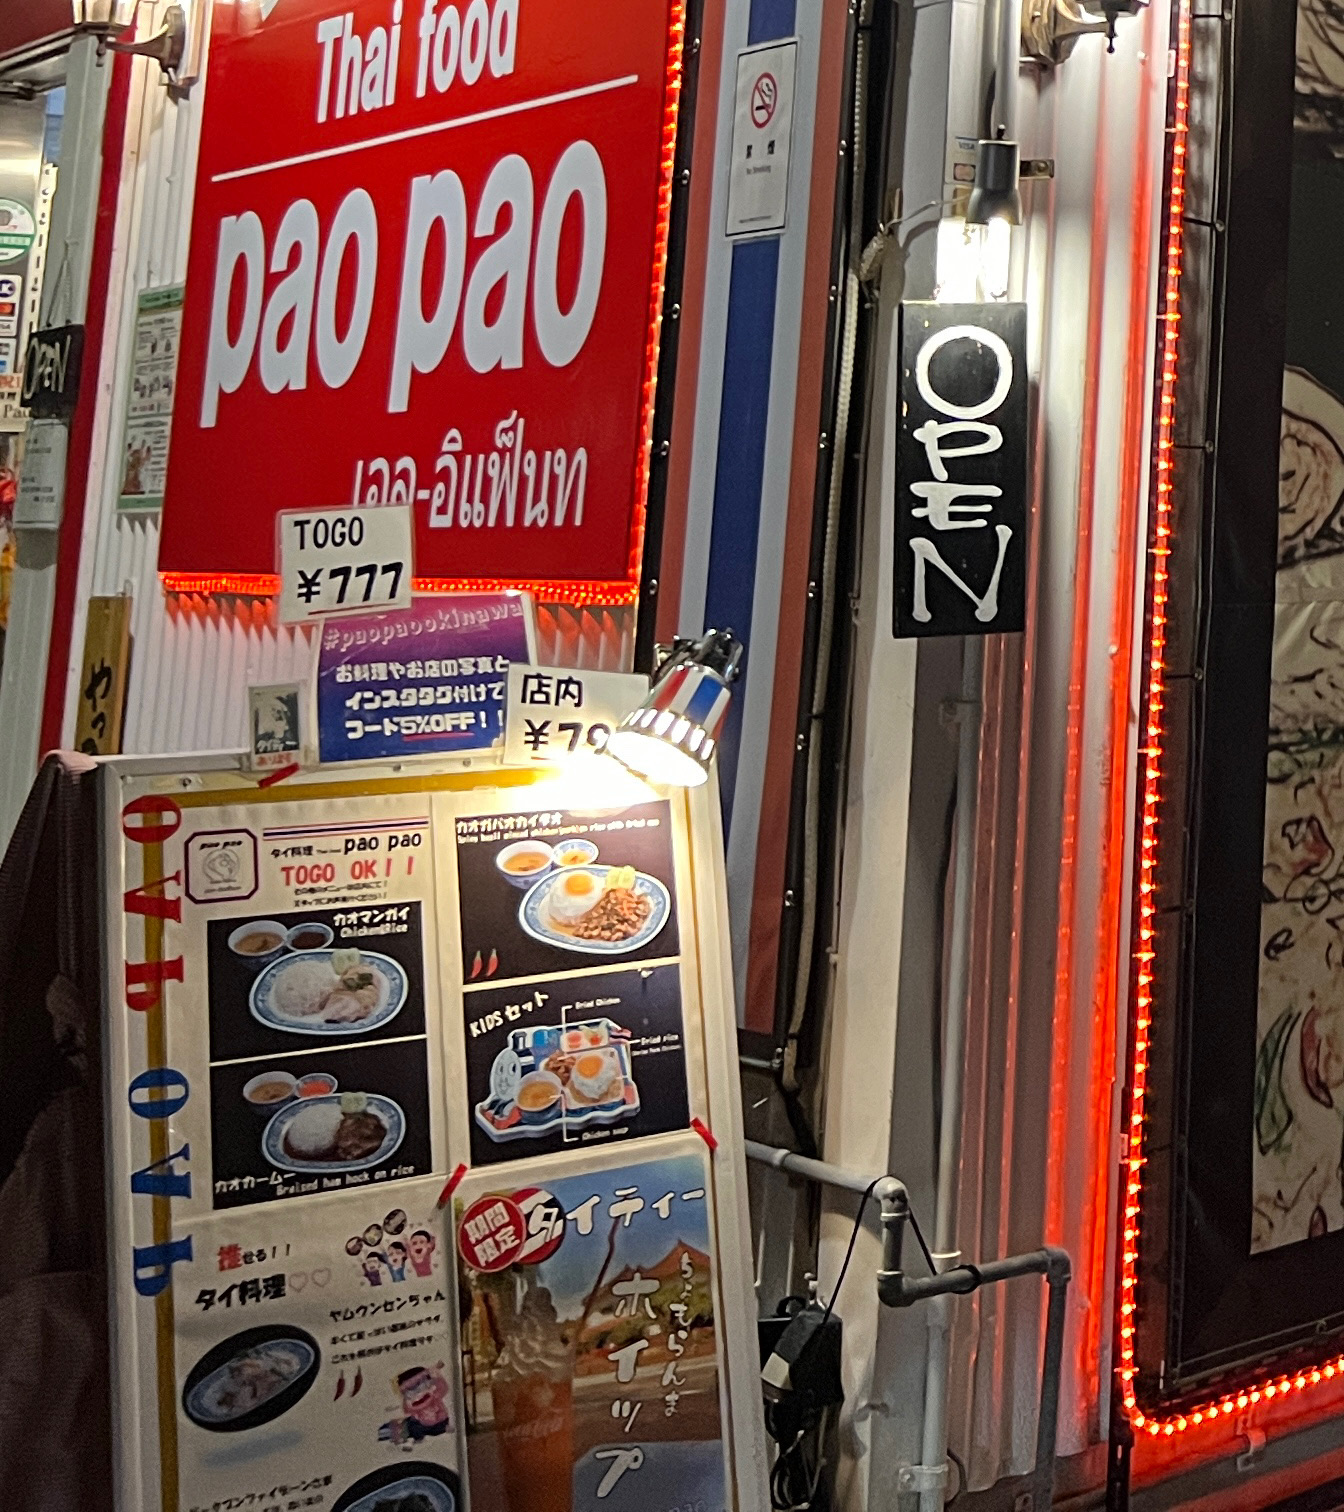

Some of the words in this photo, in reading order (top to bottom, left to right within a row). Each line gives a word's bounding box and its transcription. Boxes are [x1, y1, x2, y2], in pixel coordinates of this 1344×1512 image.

[200, 187, 379, 428] pao
[387, 139, 608, 413] pao
[909, 325, 1014, 623] OPEN
[294, 516, 365, 550] TOGO
[297, 562, 404, 604] ¥777
[324, 601, 524, 651] #paopaookinawa
[521, 673, 584, 708] 店内
[344, 835, 380, 855] pao
[388, 832, 423, 852] pao
[281, 862, 336, 886] TOGO
[333, 906, 411, 927] カオマンガイ
[468, 1010, 502, 1038] KIDS
[504, 990, 550, 1022] セット
[463, 1200, 512, 1245] 期間
[527, 1186, 706, 1243] タイティー
[473, 1224, 521, 1268] 限定
[195, 1273, 287, 1312] タイ料理
[595, 1272, 662, 1499] ホイップ
